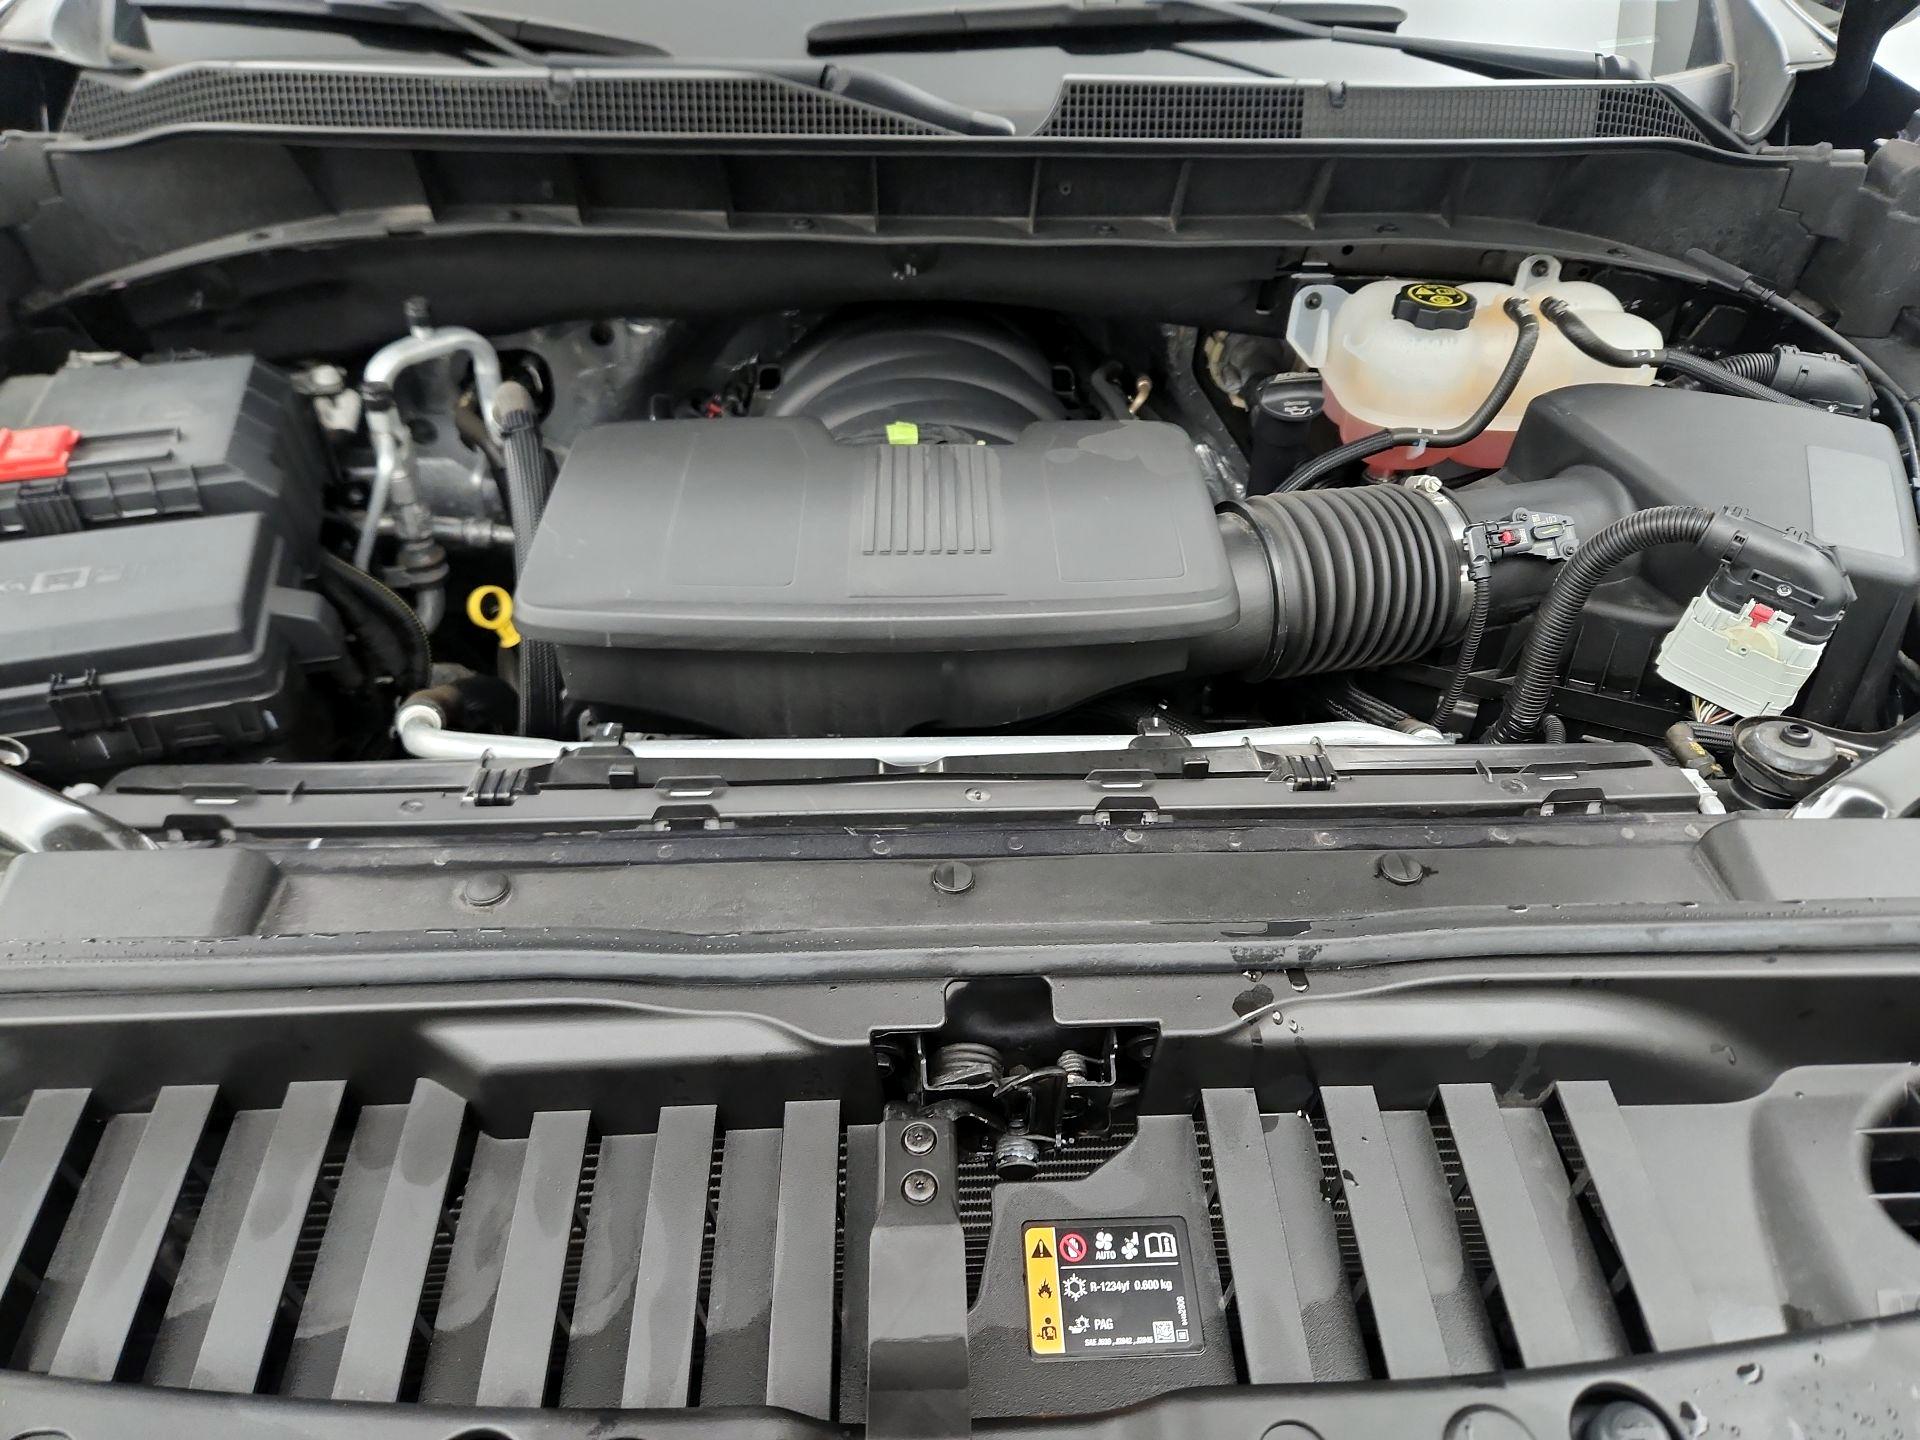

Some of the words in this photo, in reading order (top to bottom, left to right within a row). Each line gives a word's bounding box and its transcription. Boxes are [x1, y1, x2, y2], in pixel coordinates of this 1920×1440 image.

[1095, 1250, 1116, 1260] AUTO
[1090, 1281, 1130, 1293] R-1234yf
[1134, 1280, 1159, 1291] 0.600
[1160, 1279, 1173, 1291] kg
[1094, 1318, 1114, 1330] PAG
